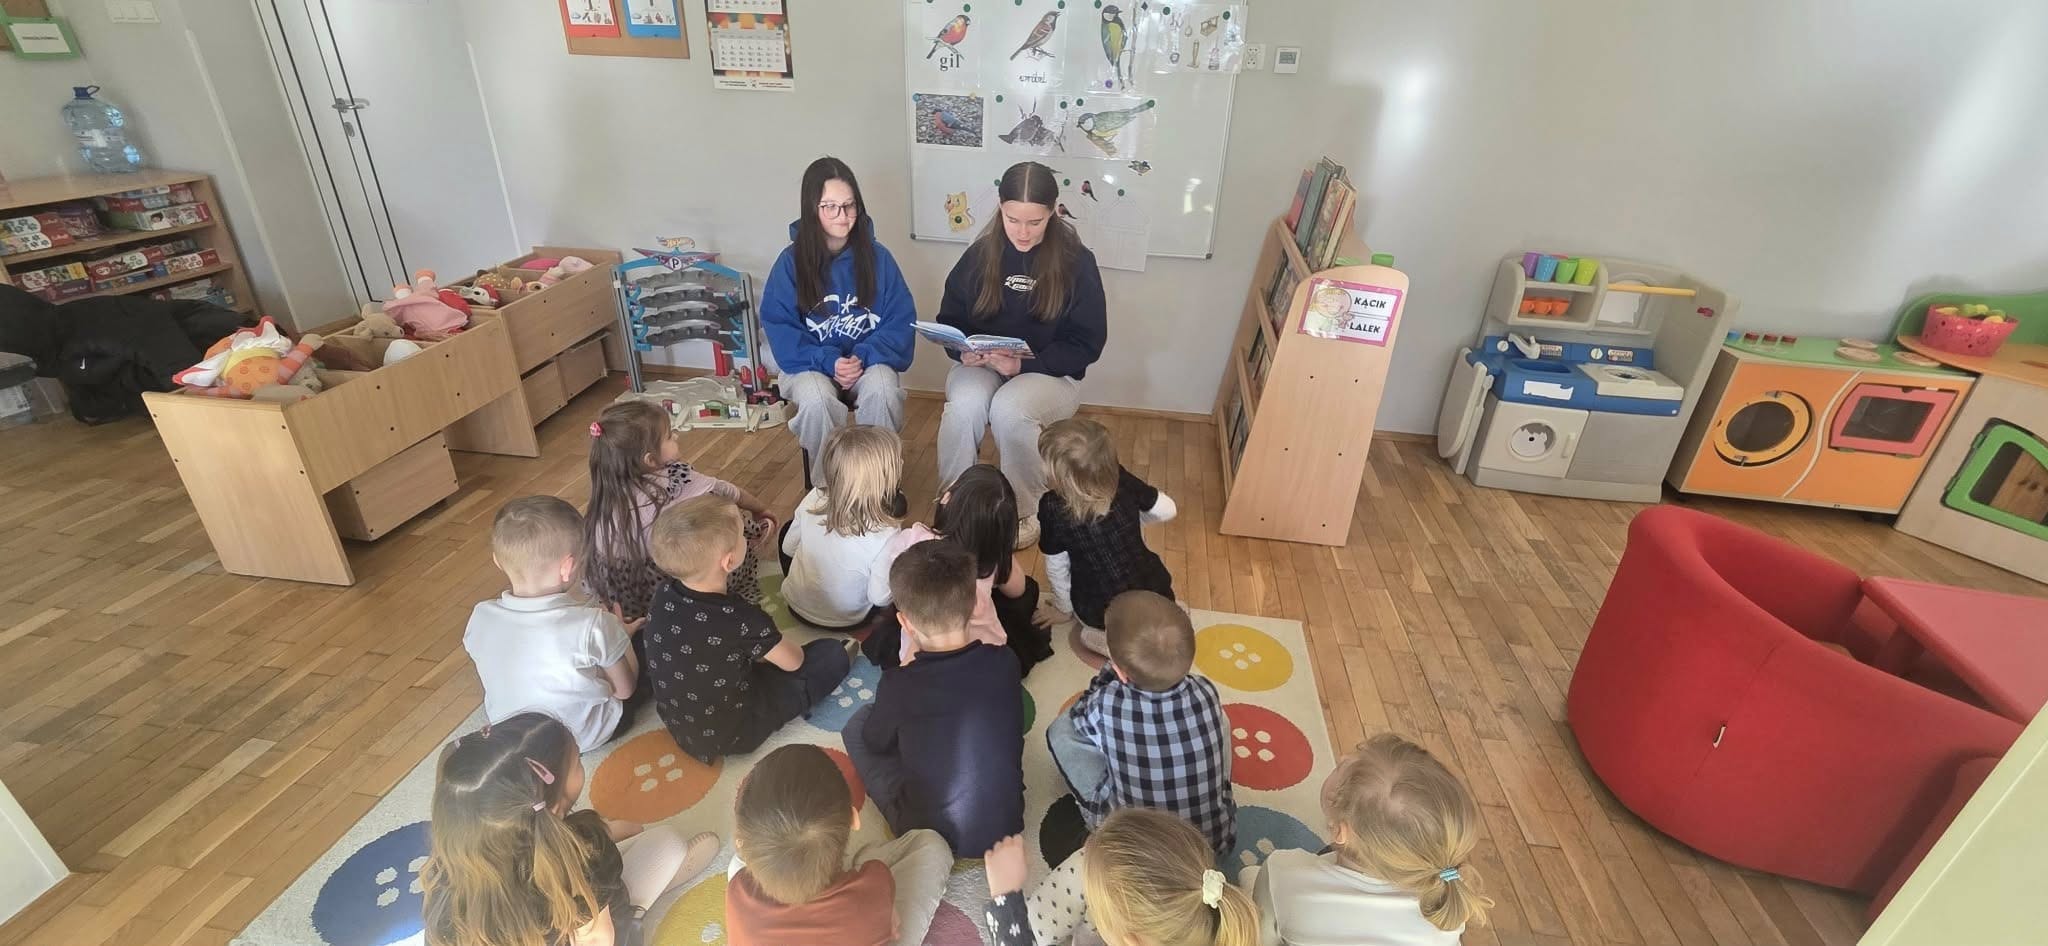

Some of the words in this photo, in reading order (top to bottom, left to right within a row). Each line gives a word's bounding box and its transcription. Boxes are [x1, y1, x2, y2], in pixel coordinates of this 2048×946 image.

[940, 53, 960, 72] gil
[672, 258, 679, 269] P
[1354, 297, 1387, 309] KĄCIK
[1349, 322, 1381, 334] LALEK
